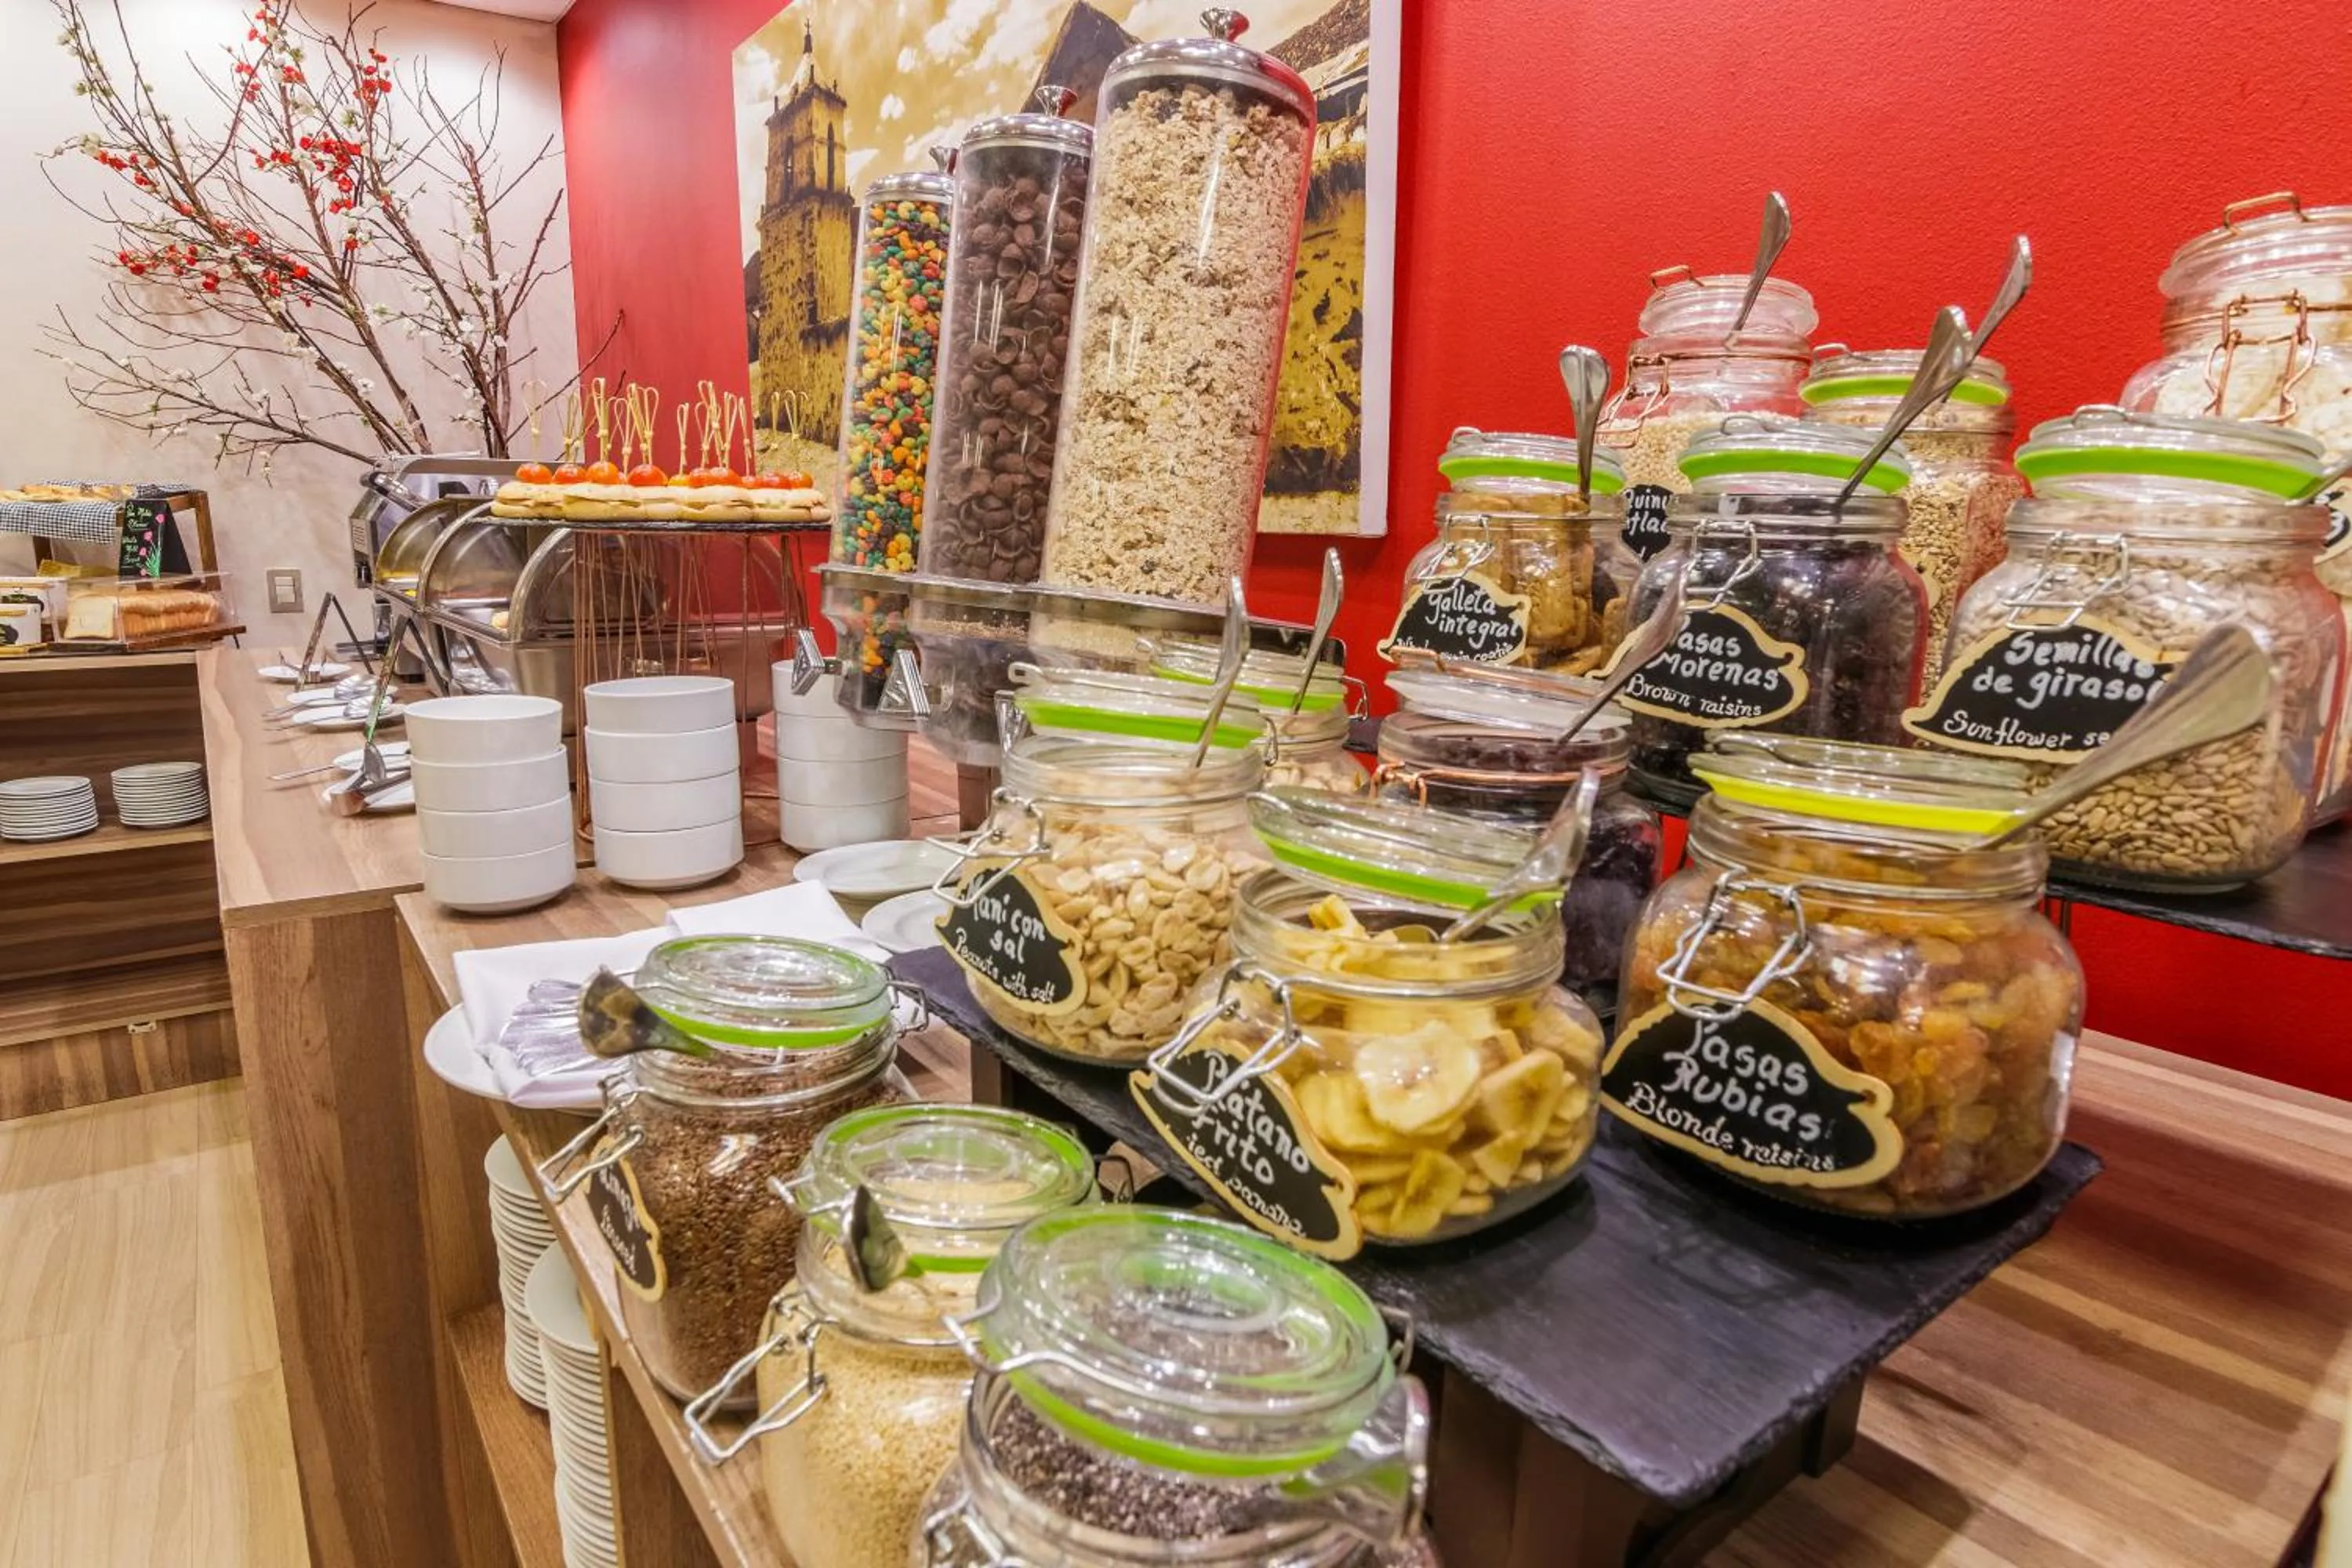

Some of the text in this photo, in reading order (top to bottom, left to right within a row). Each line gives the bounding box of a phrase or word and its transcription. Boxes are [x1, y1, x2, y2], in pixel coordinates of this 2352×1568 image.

[1425, 584, 1497, 625] galleta
[1439, 614, 1519, 649] integral
[1676, 614, 1742, 657] asas
[1646, 652, 1780, 691] Morenas
[1972, 666, 2013, 693] de
[1626, 673, 1762, 717] Brown raisins
[1944, 710, 2072, 749] Sunflower
[1010, 909, 1046, 942] con
[989, 930, 1025, 964] sal
[1625, 1080, 1734, 1151] Blonde
[1661, 1051, 1822, 1141] Rubias
